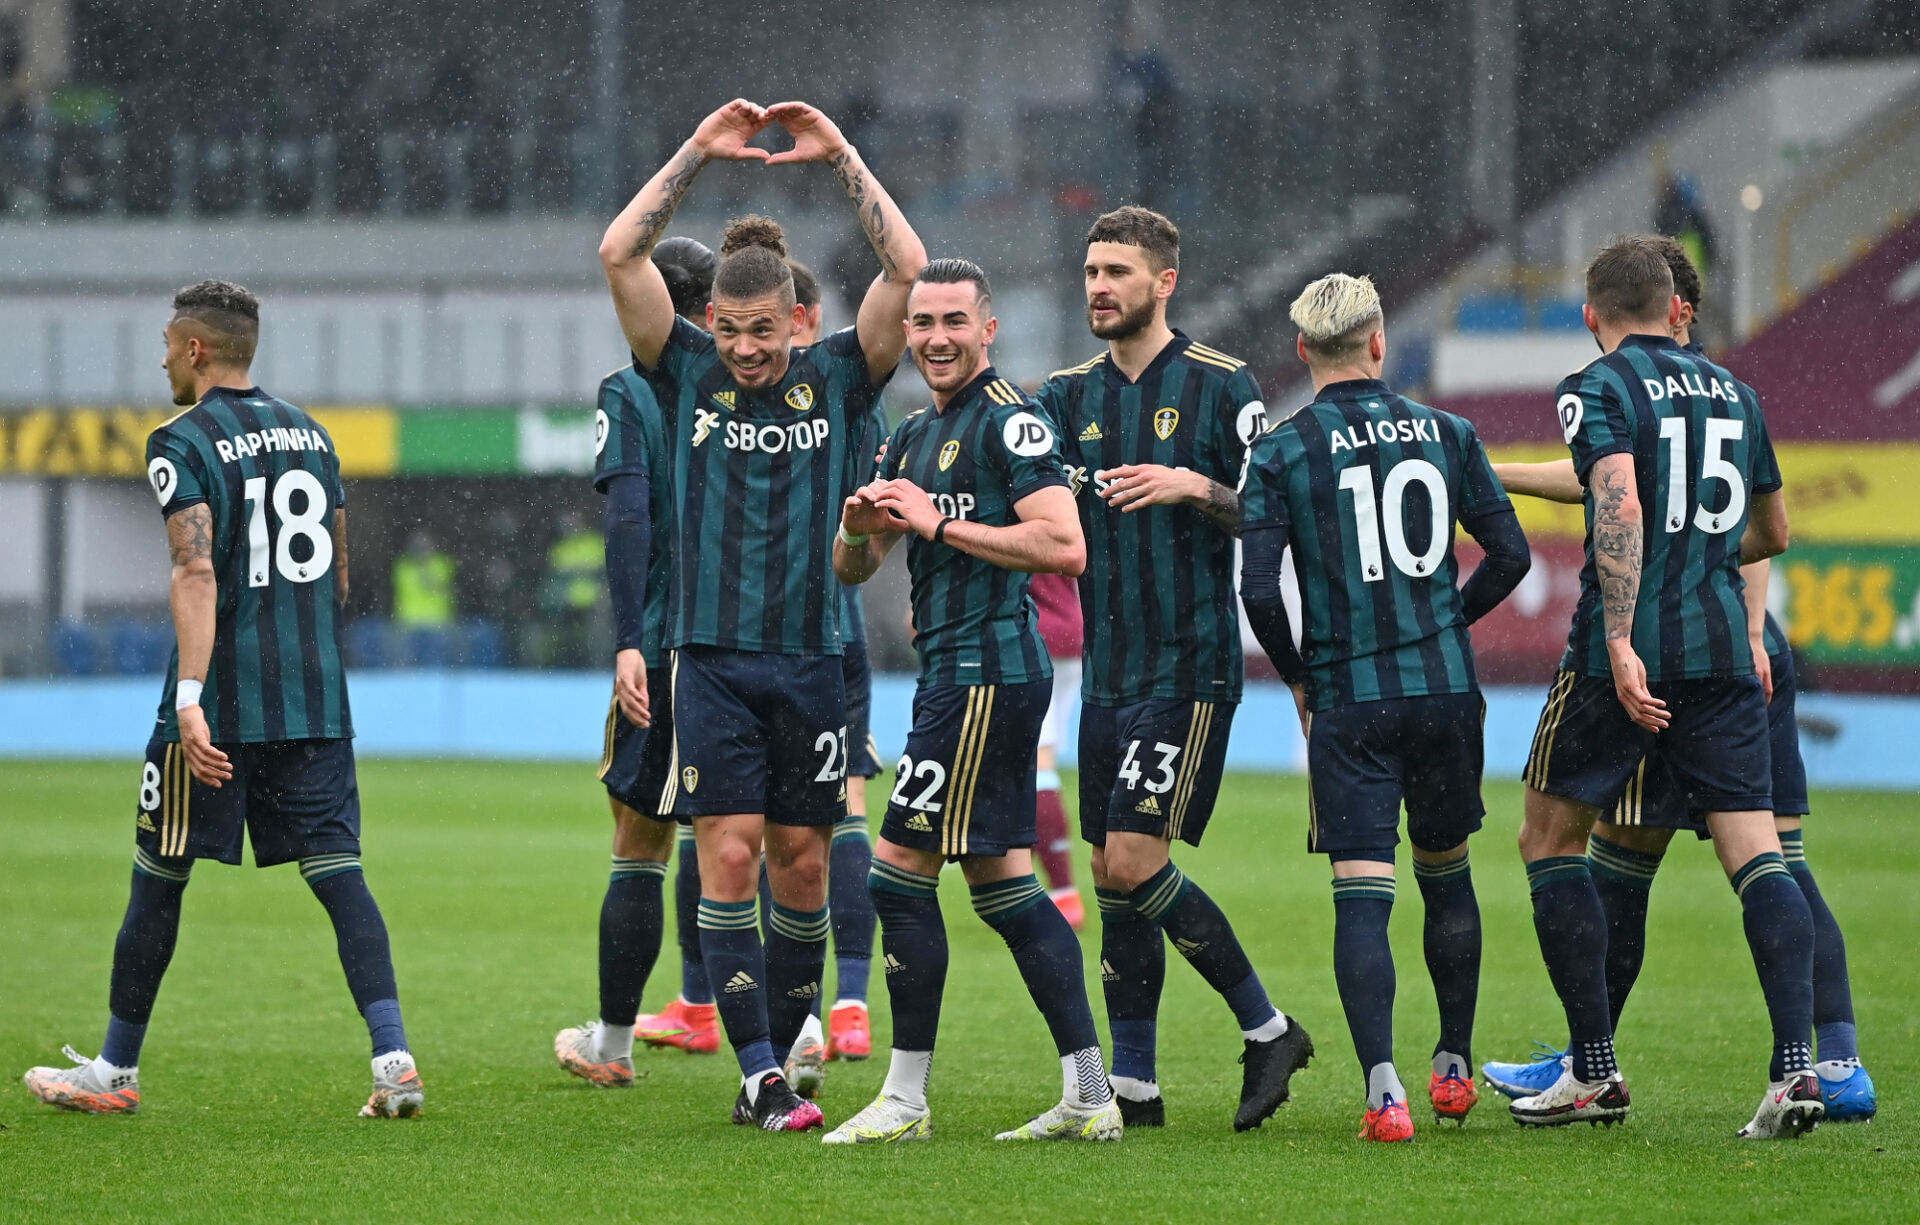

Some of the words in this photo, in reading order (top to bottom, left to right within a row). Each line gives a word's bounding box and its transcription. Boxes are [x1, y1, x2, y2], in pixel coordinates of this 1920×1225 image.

[1643, 373, 1740, 403] DALLAS
[215, 427, 329, 464] RAPHINHA
[724, 418, 829, 454] SBOTOP
[1014, 422, 1046, 449] JD
[1078, 432, 1104, 442] adidas
[1330, 418, 1442, 454] ALIOSKI
[1658, 416, 1746, 534] 15
[244, 469, 333, 588] 18
[1338, 458, 1450, 583] 10
[891, 754, 946, 813] 22
[1118, 740, 1182, 794] 43
[904, 821, 933, 832] adidas
[1135, 805, 1163, 816] adidas
[724, 982, 759, 994] adidas
